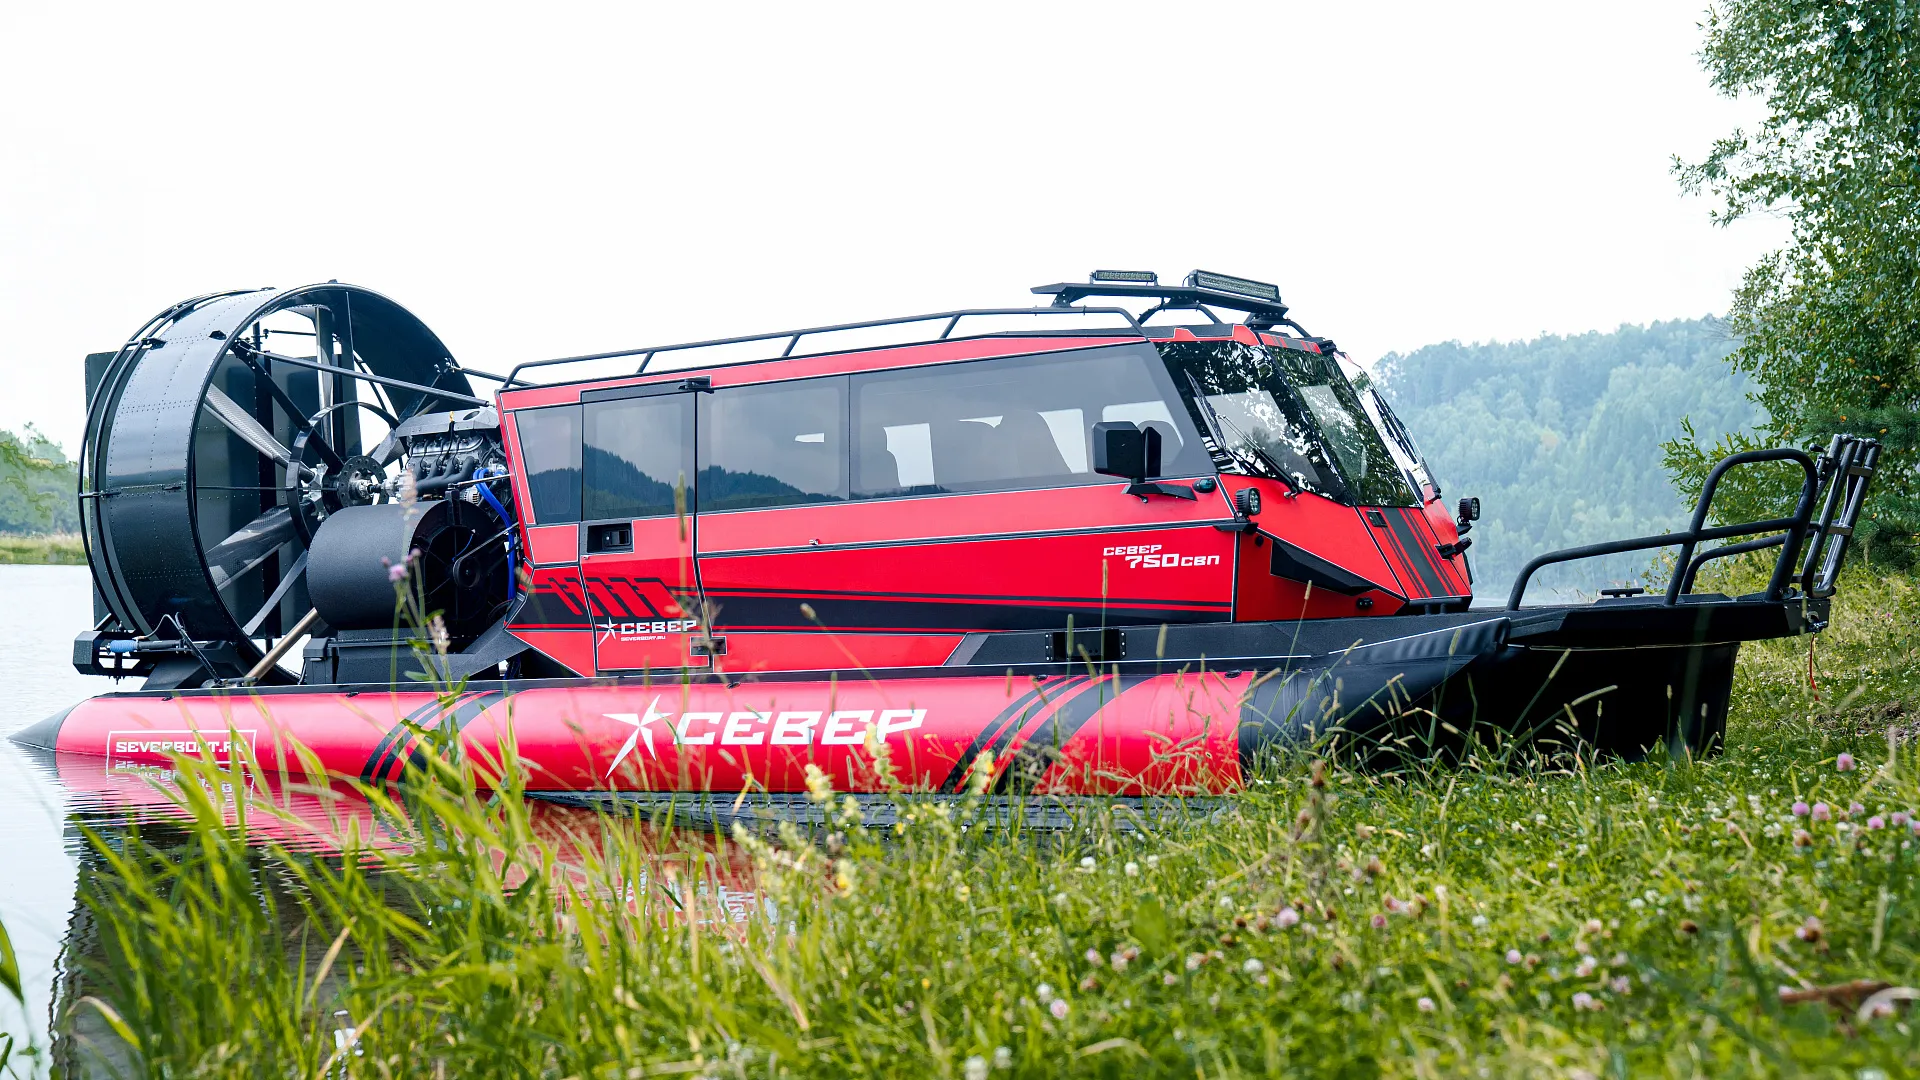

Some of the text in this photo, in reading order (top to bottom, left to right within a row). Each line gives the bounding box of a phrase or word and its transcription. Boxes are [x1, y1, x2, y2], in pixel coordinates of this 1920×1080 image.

[1103, 544, 1162, 556] СЕВЕР
[1125, 553, 1180, 568] 750
[620, 620, 697, 635] СЕВЕР
[673, 709, 928, 745] СЕВЕР
